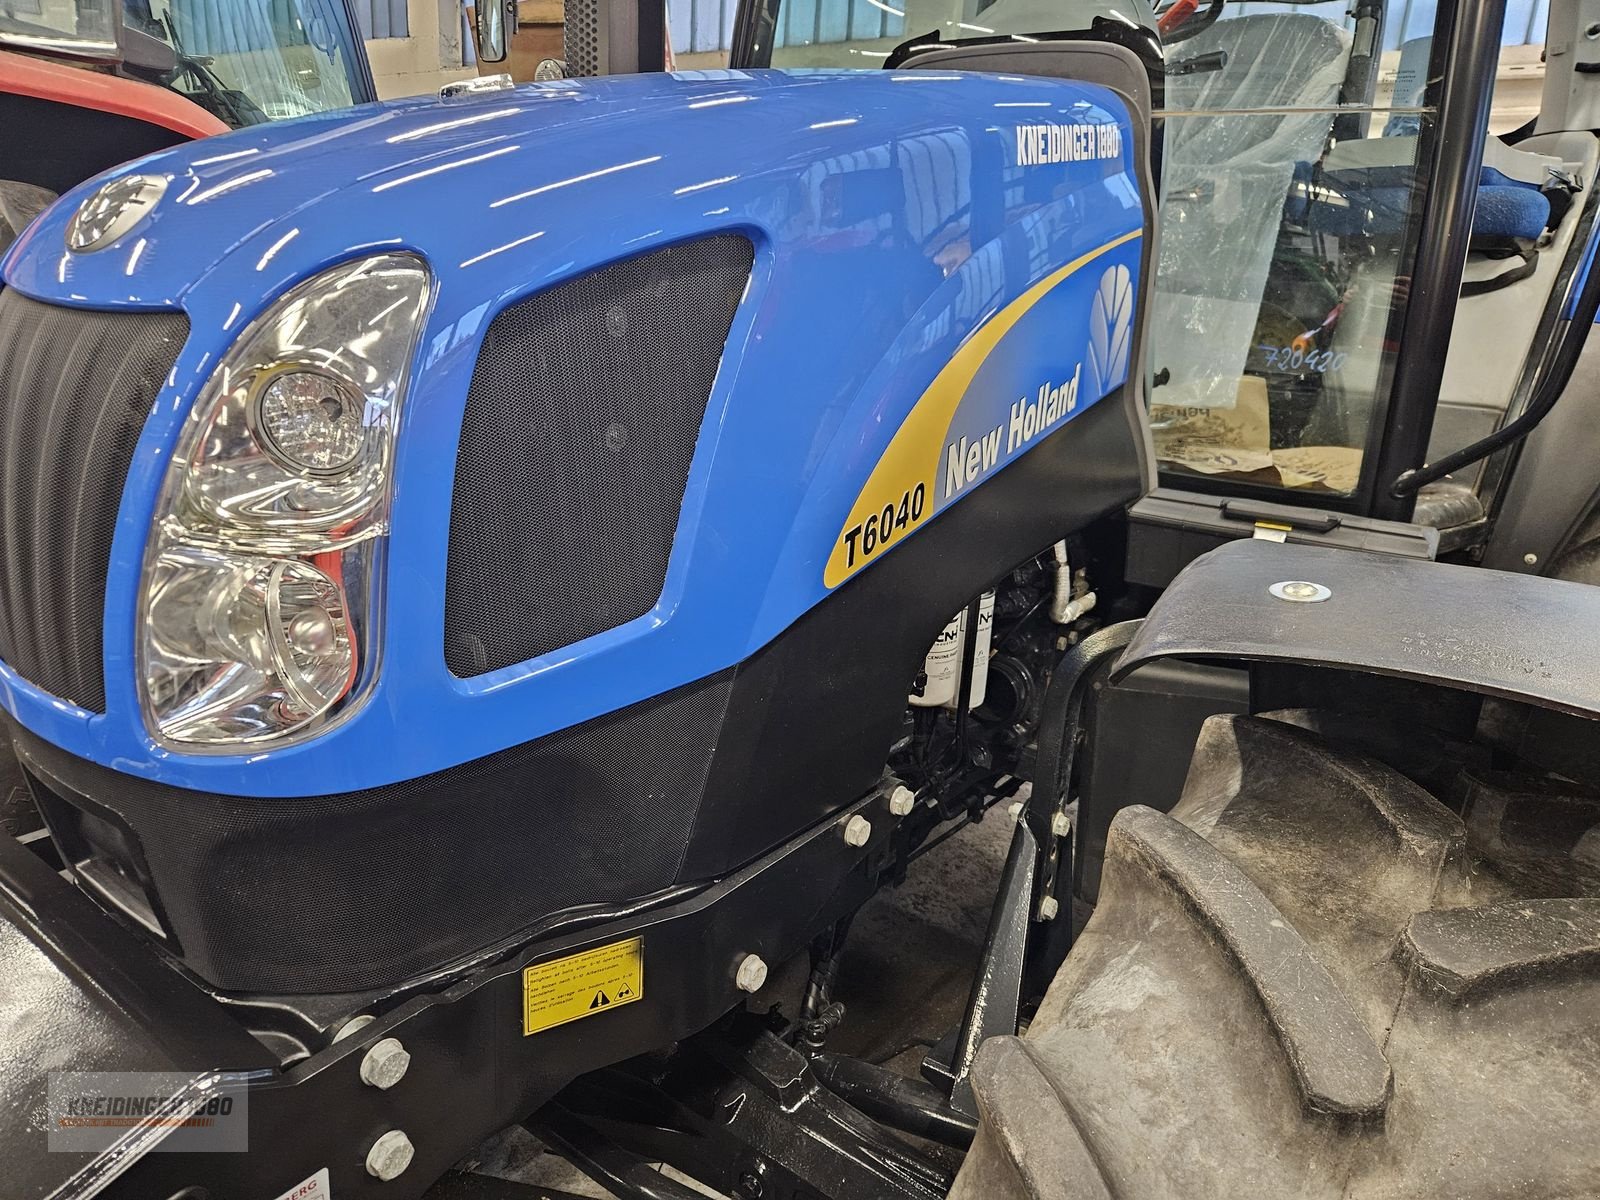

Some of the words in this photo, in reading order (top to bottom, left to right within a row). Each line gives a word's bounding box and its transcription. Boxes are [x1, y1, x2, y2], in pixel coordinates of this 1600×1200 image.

[1016, 125, 1096, 166] KNEIDINGER
[1097, 124, 1119, 160] 1880
[944, 425, 1002, 498] New
[1006, 362, 1082, 455] Holland
[843, 483, 926, 569] T6040
[285, 1180, 317, 1200] ERG
